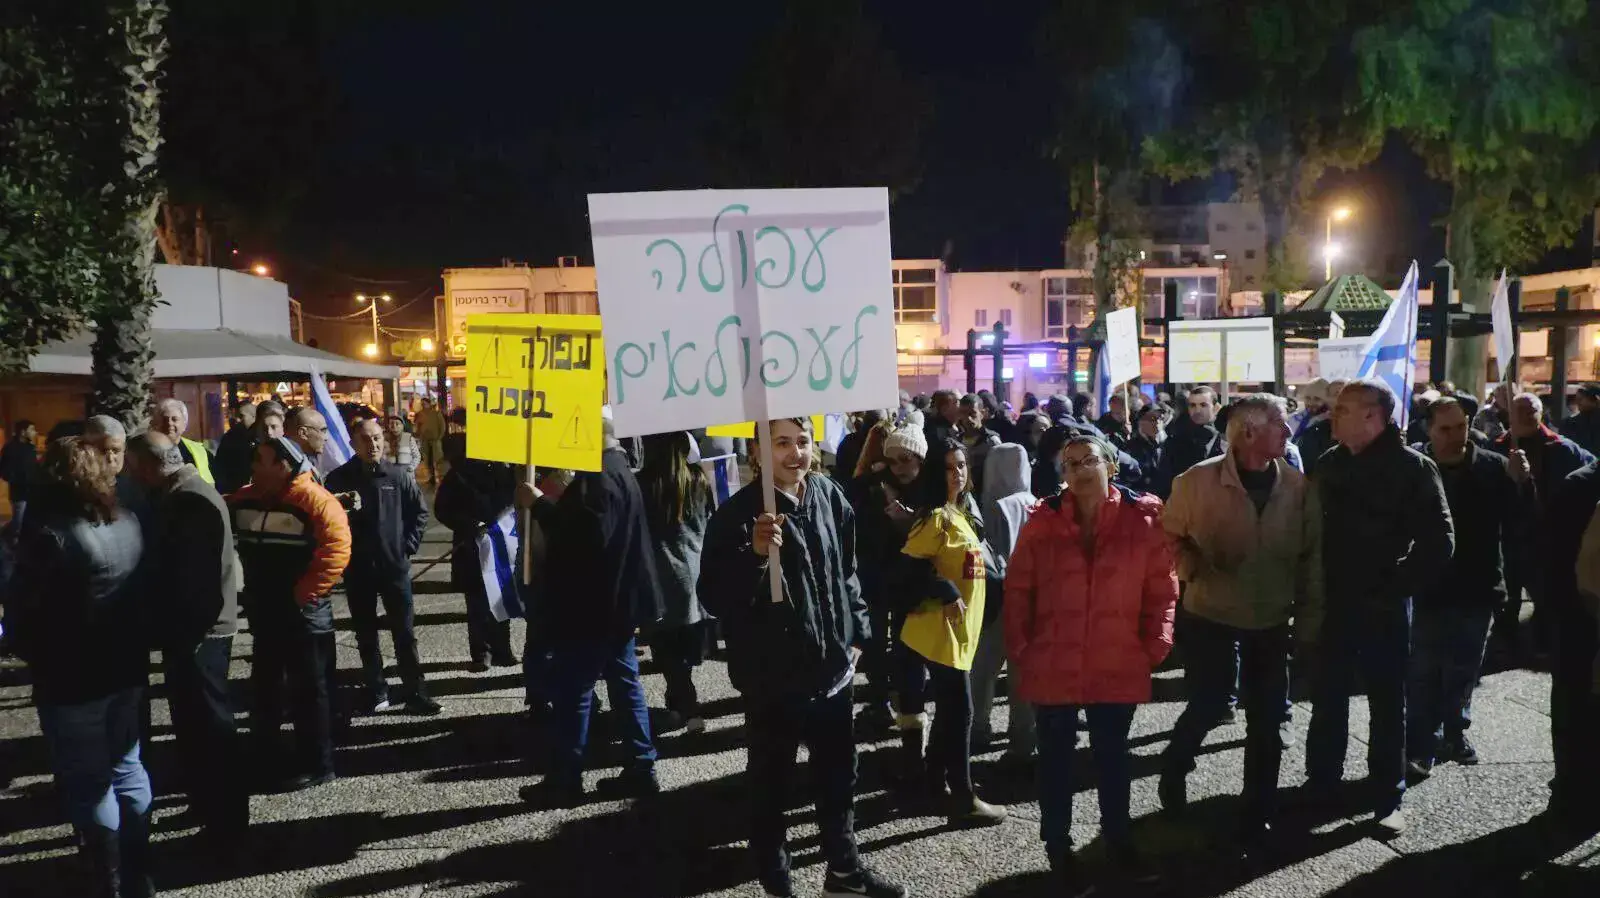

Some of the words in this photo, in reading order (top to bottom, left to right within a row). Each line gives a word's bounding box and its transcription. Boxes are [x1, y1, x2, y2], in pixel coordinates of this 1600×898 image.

[645, 204, 842, 293] עפולה
[521, 326, 592, 370] עפולה
[614, 305, 878, 404] לעפולאים
[475, 385, 553, 419] בסכנה
